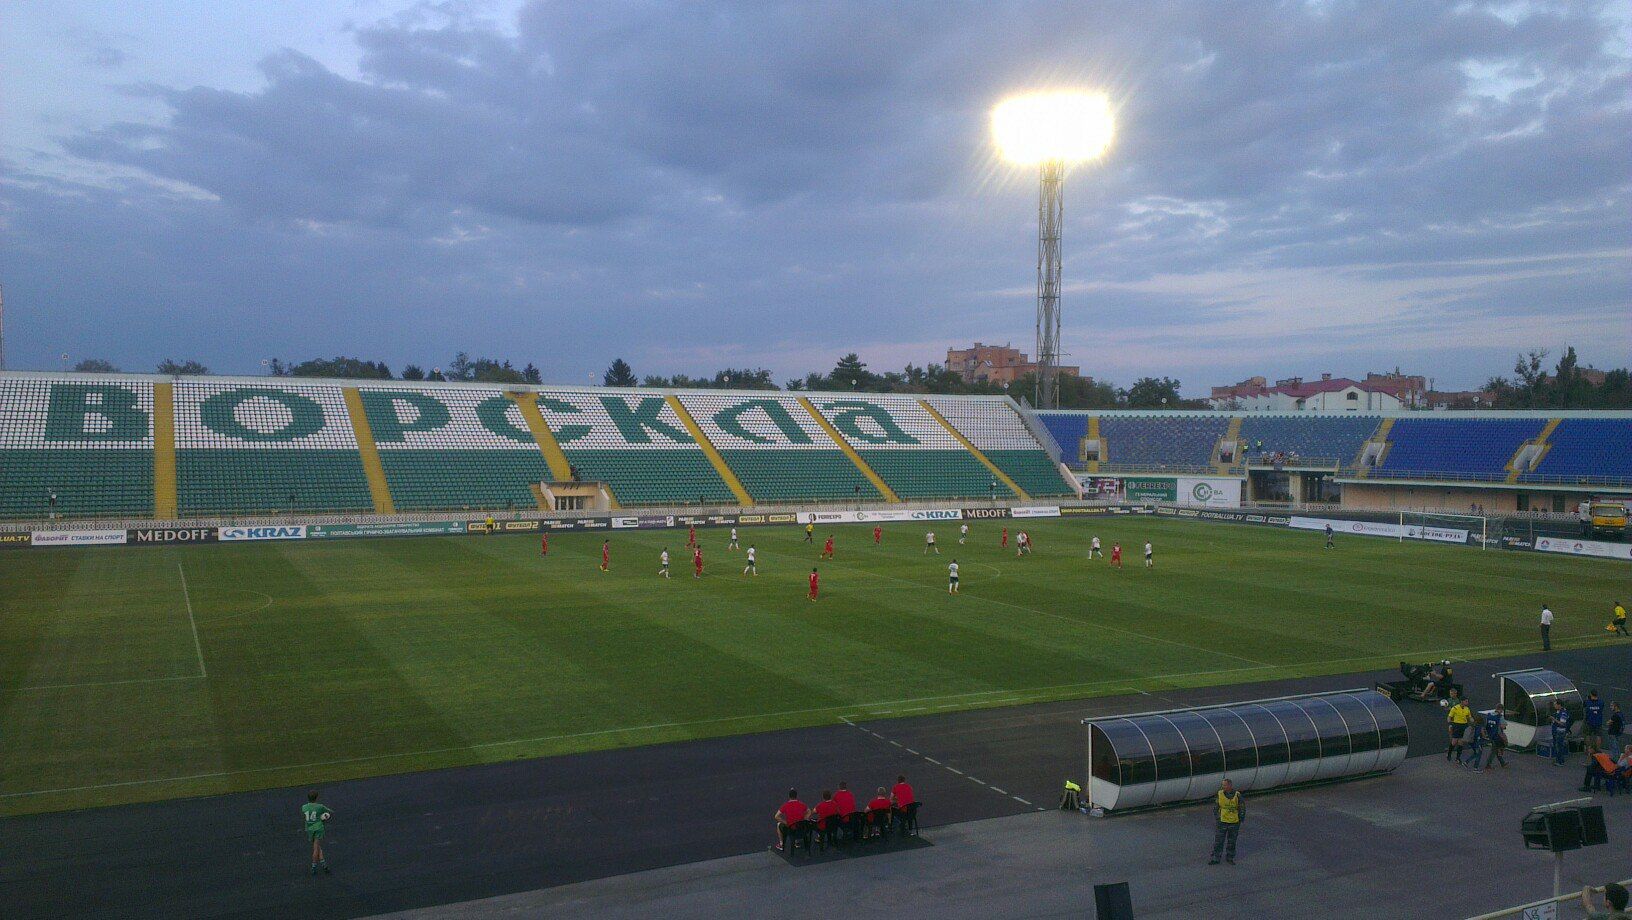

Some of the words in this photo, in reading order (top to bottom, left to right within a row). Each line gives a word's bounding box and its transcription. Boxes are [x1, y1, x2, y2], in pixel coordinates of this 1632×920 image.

[926, 510, 959, 519] KRAZ
[966, 509, 1007, 518] MEDOFF
[137, 529, 209, 542] MEDOFF
[247, 527, 302, 538] KRAZ
[304, 810, 317, 821] 14
